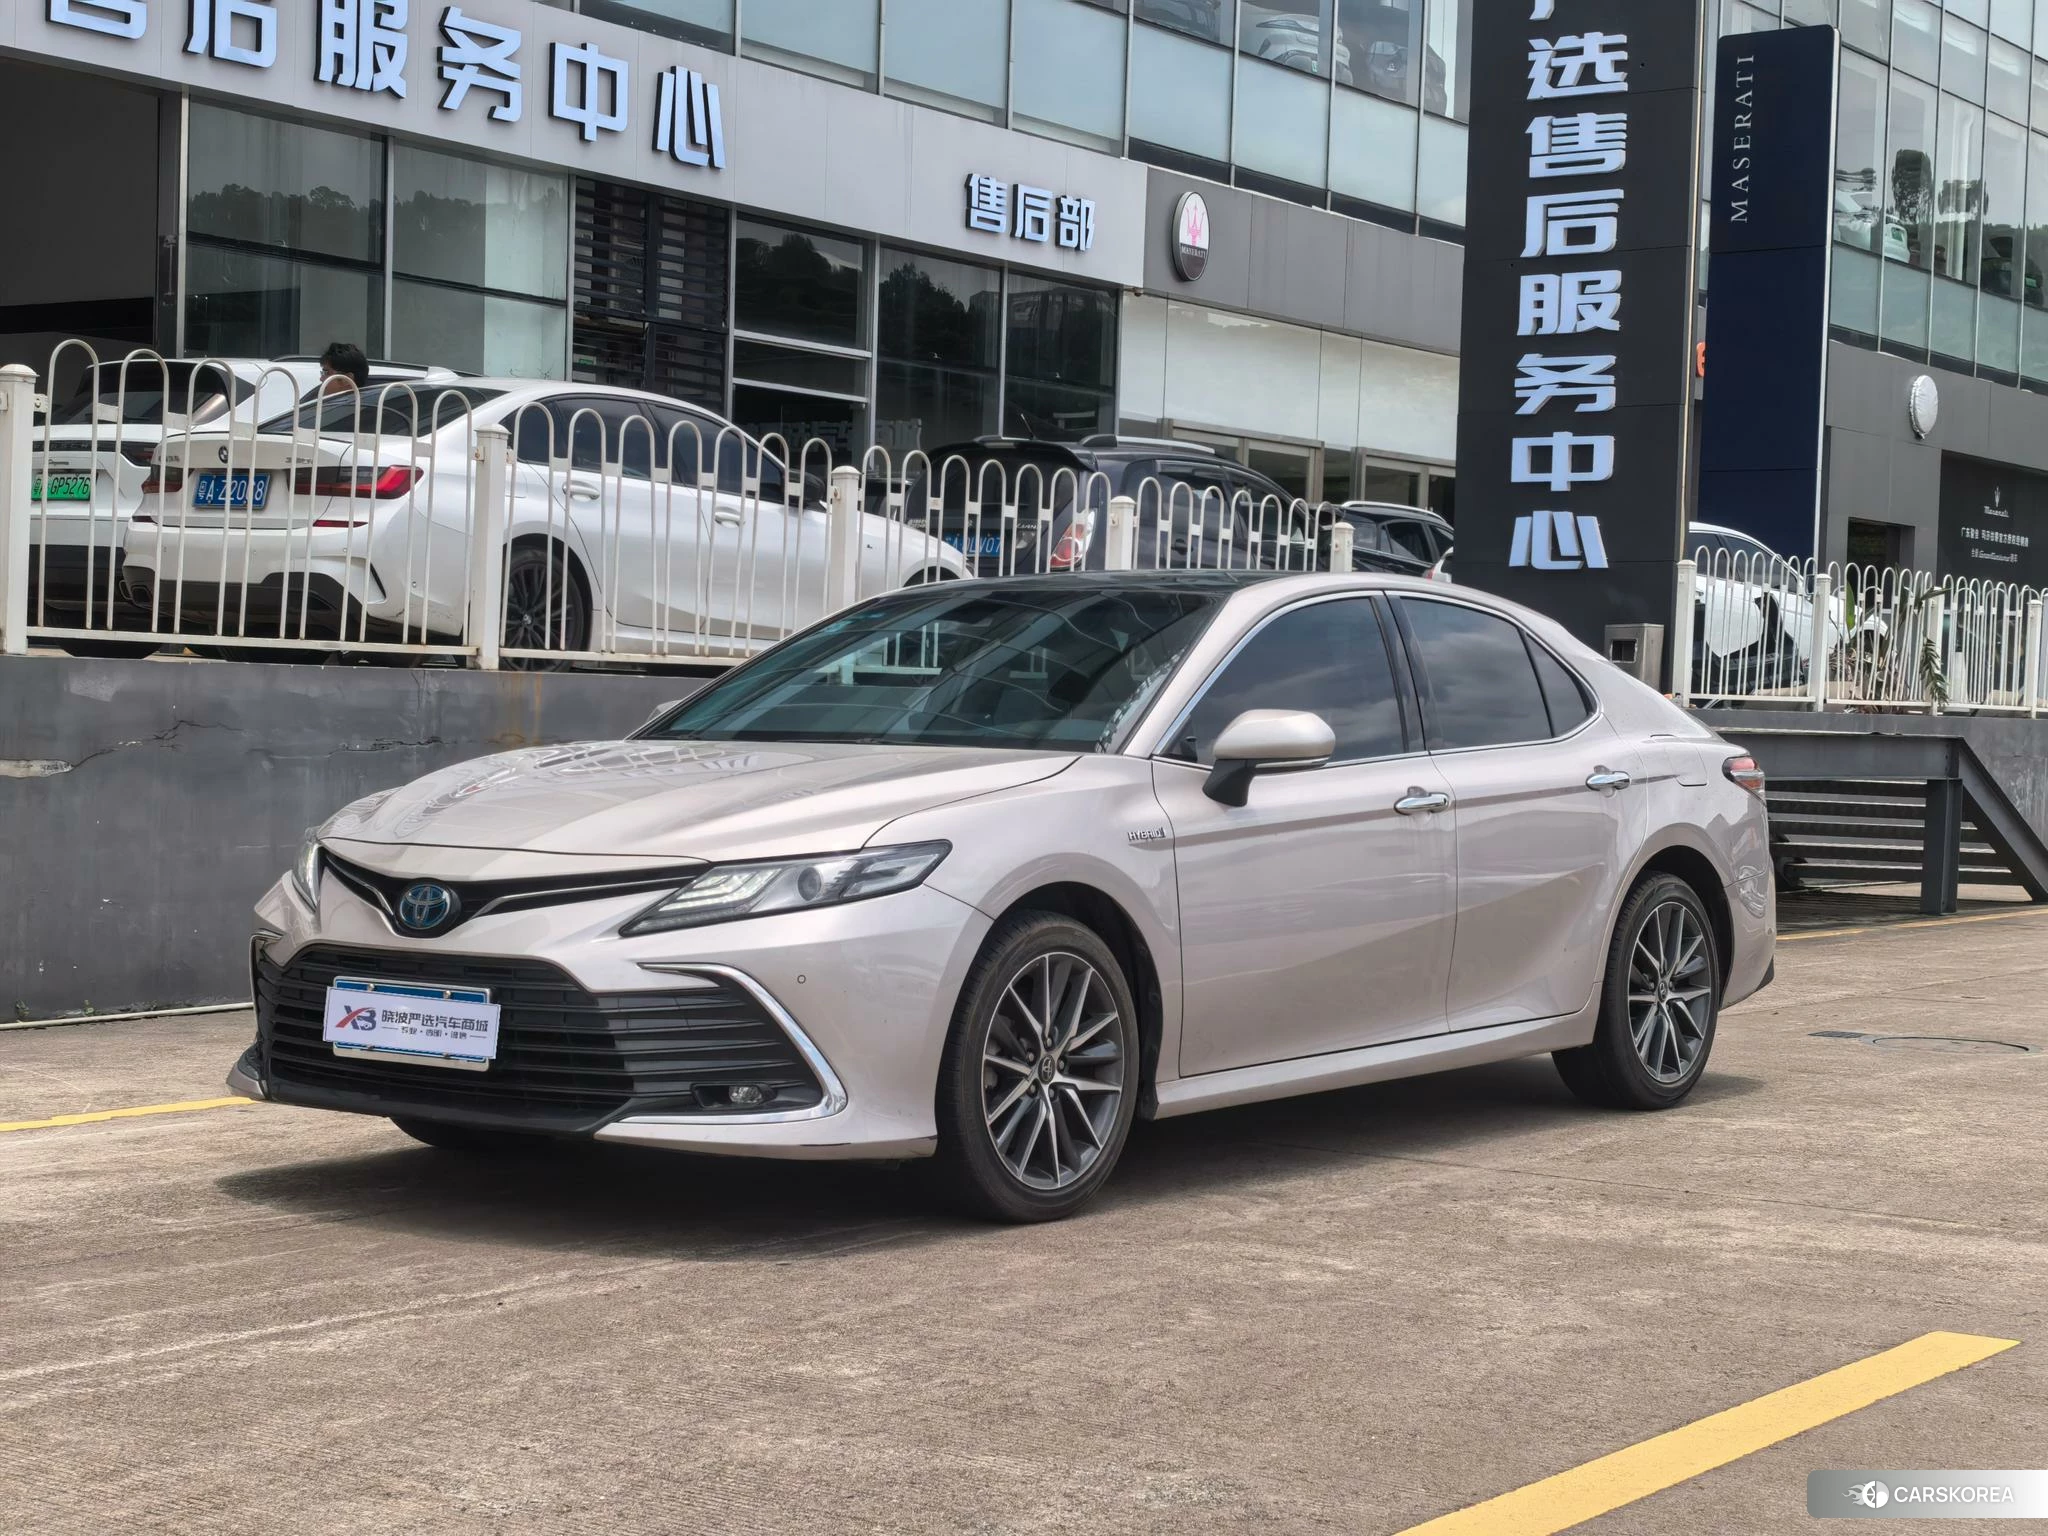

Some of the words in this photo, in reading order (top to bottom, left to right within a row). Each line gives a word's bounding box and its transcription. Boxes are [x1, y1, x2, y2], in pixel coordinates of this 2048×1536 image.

[1730, 54, 1755, 223] MASERATI
[965, 172, 1096, 251] 售后部
[1508, 0, 1630, 570] 选售后服务中心
[381, 1009, 489, 1032] 晓波严选汽车商城
